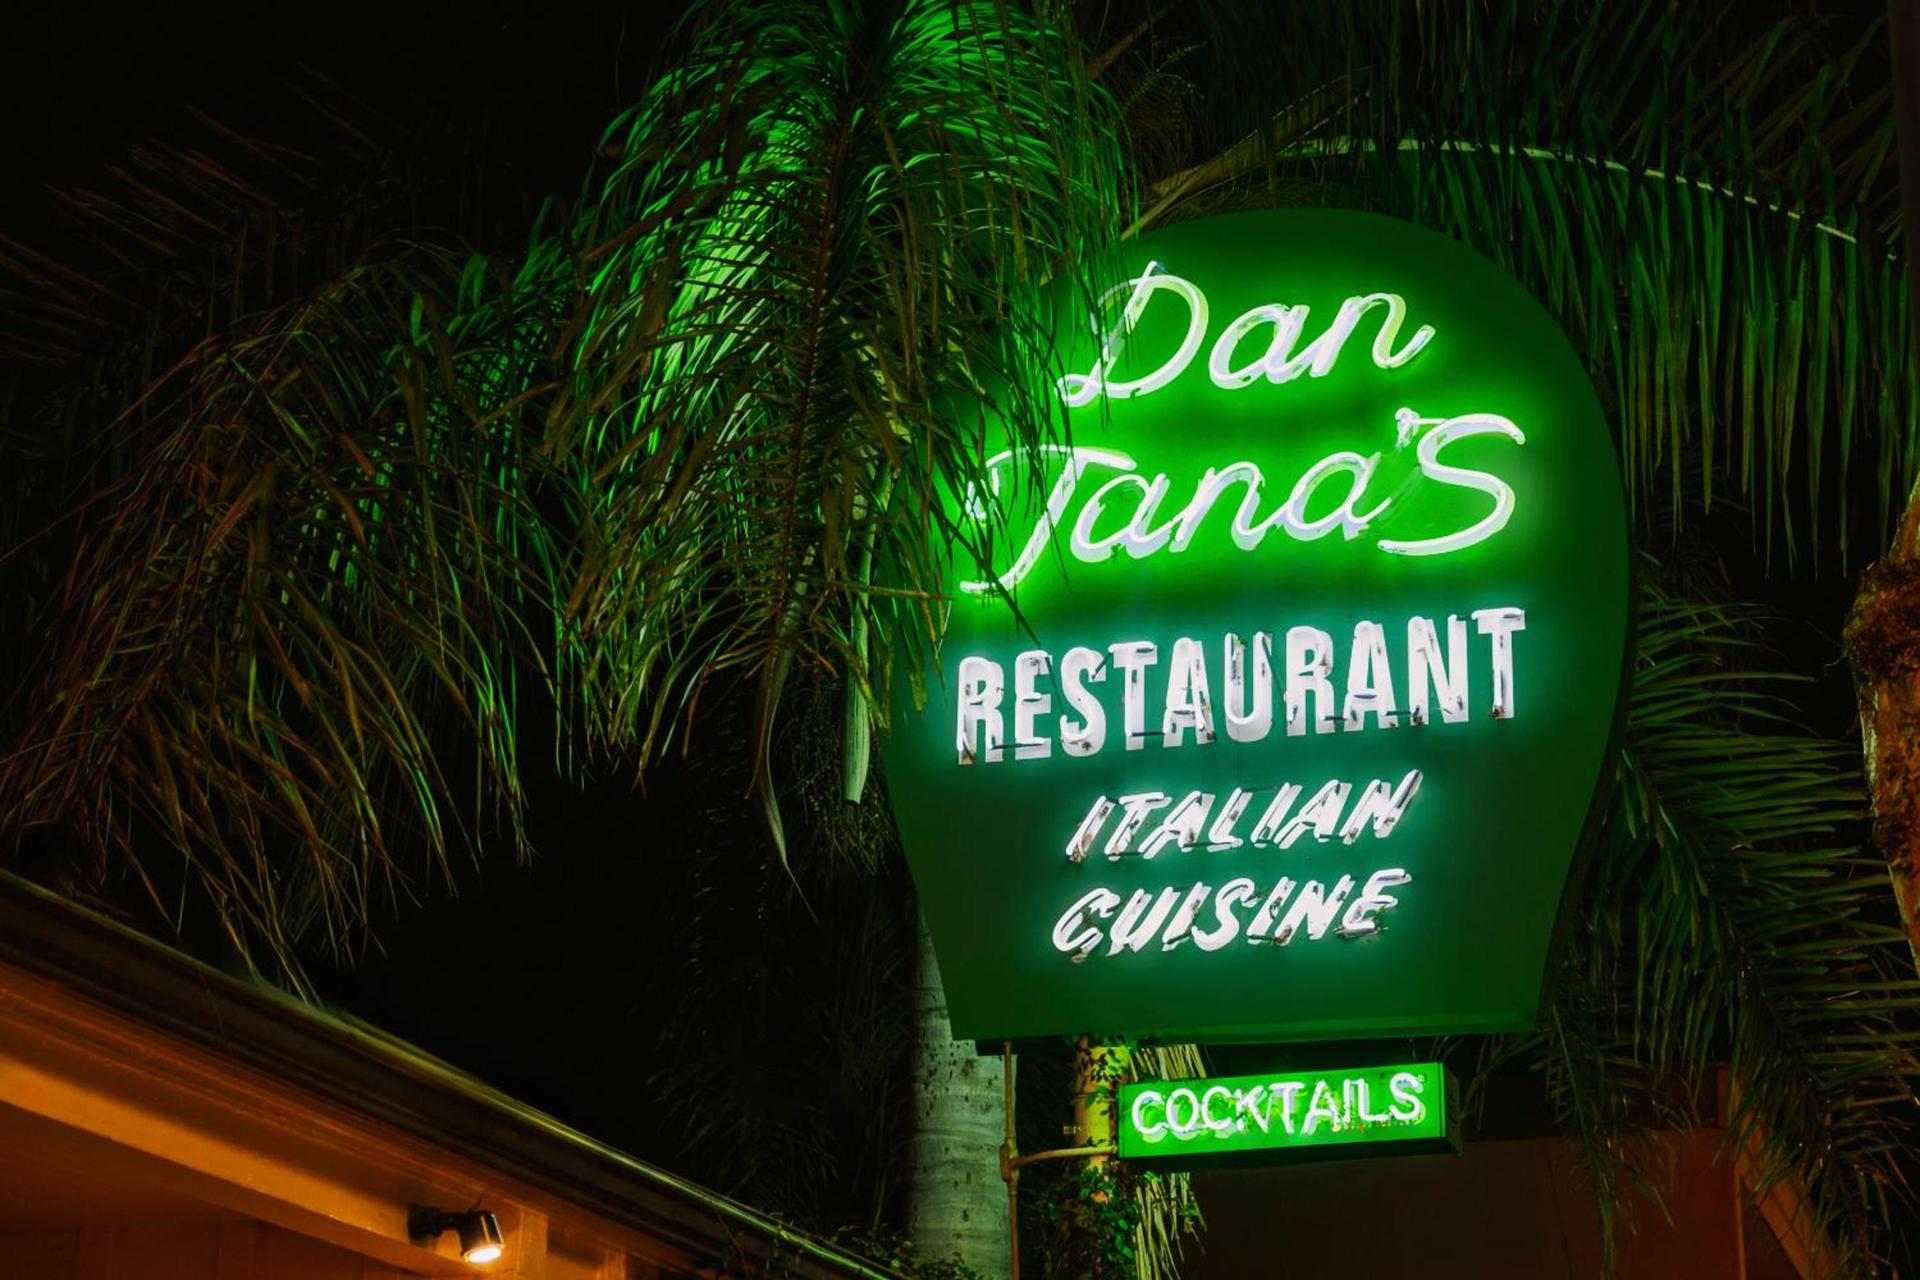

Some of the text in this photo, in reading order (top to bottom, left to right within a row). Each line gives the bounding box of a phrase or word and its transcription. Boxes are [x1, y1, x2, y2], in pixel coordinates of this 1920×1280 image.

[1055, 260, 1436, 408] Dan
[955, 606, 1526, 766] RESTAURANT
[1065, 769, 1424, 863] ITALIAN
[1052, 868, 1413, 963] CUISINE
[1131, 1072, 1426, 1143] COCKTAILS
